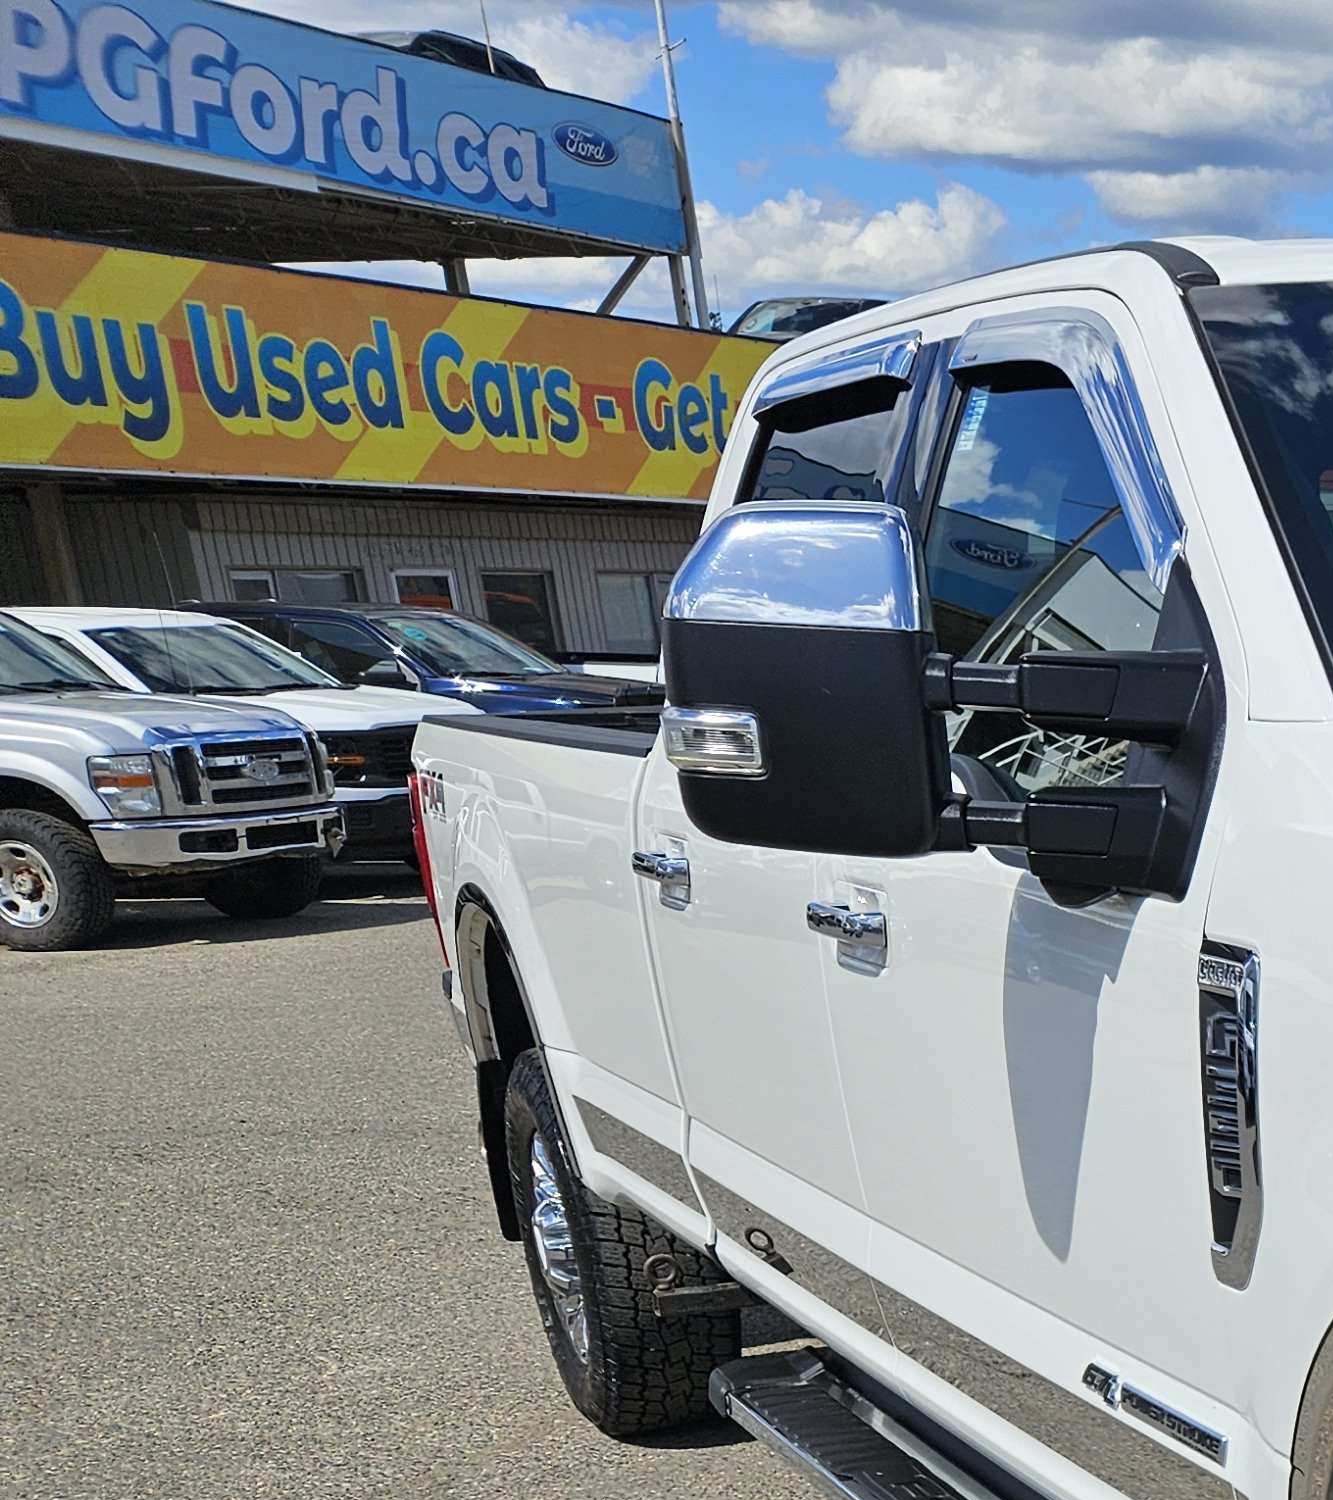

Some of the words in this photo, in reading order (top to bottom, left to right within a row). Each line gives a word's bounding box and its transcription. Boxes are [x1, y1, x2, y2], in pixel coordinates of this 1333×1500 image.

[566, 127, 606, 161] Ford
[186, 303, 405, 430] Used
[420, 332, 580, 444] Cars
[634, 359, 728, 455] Get
